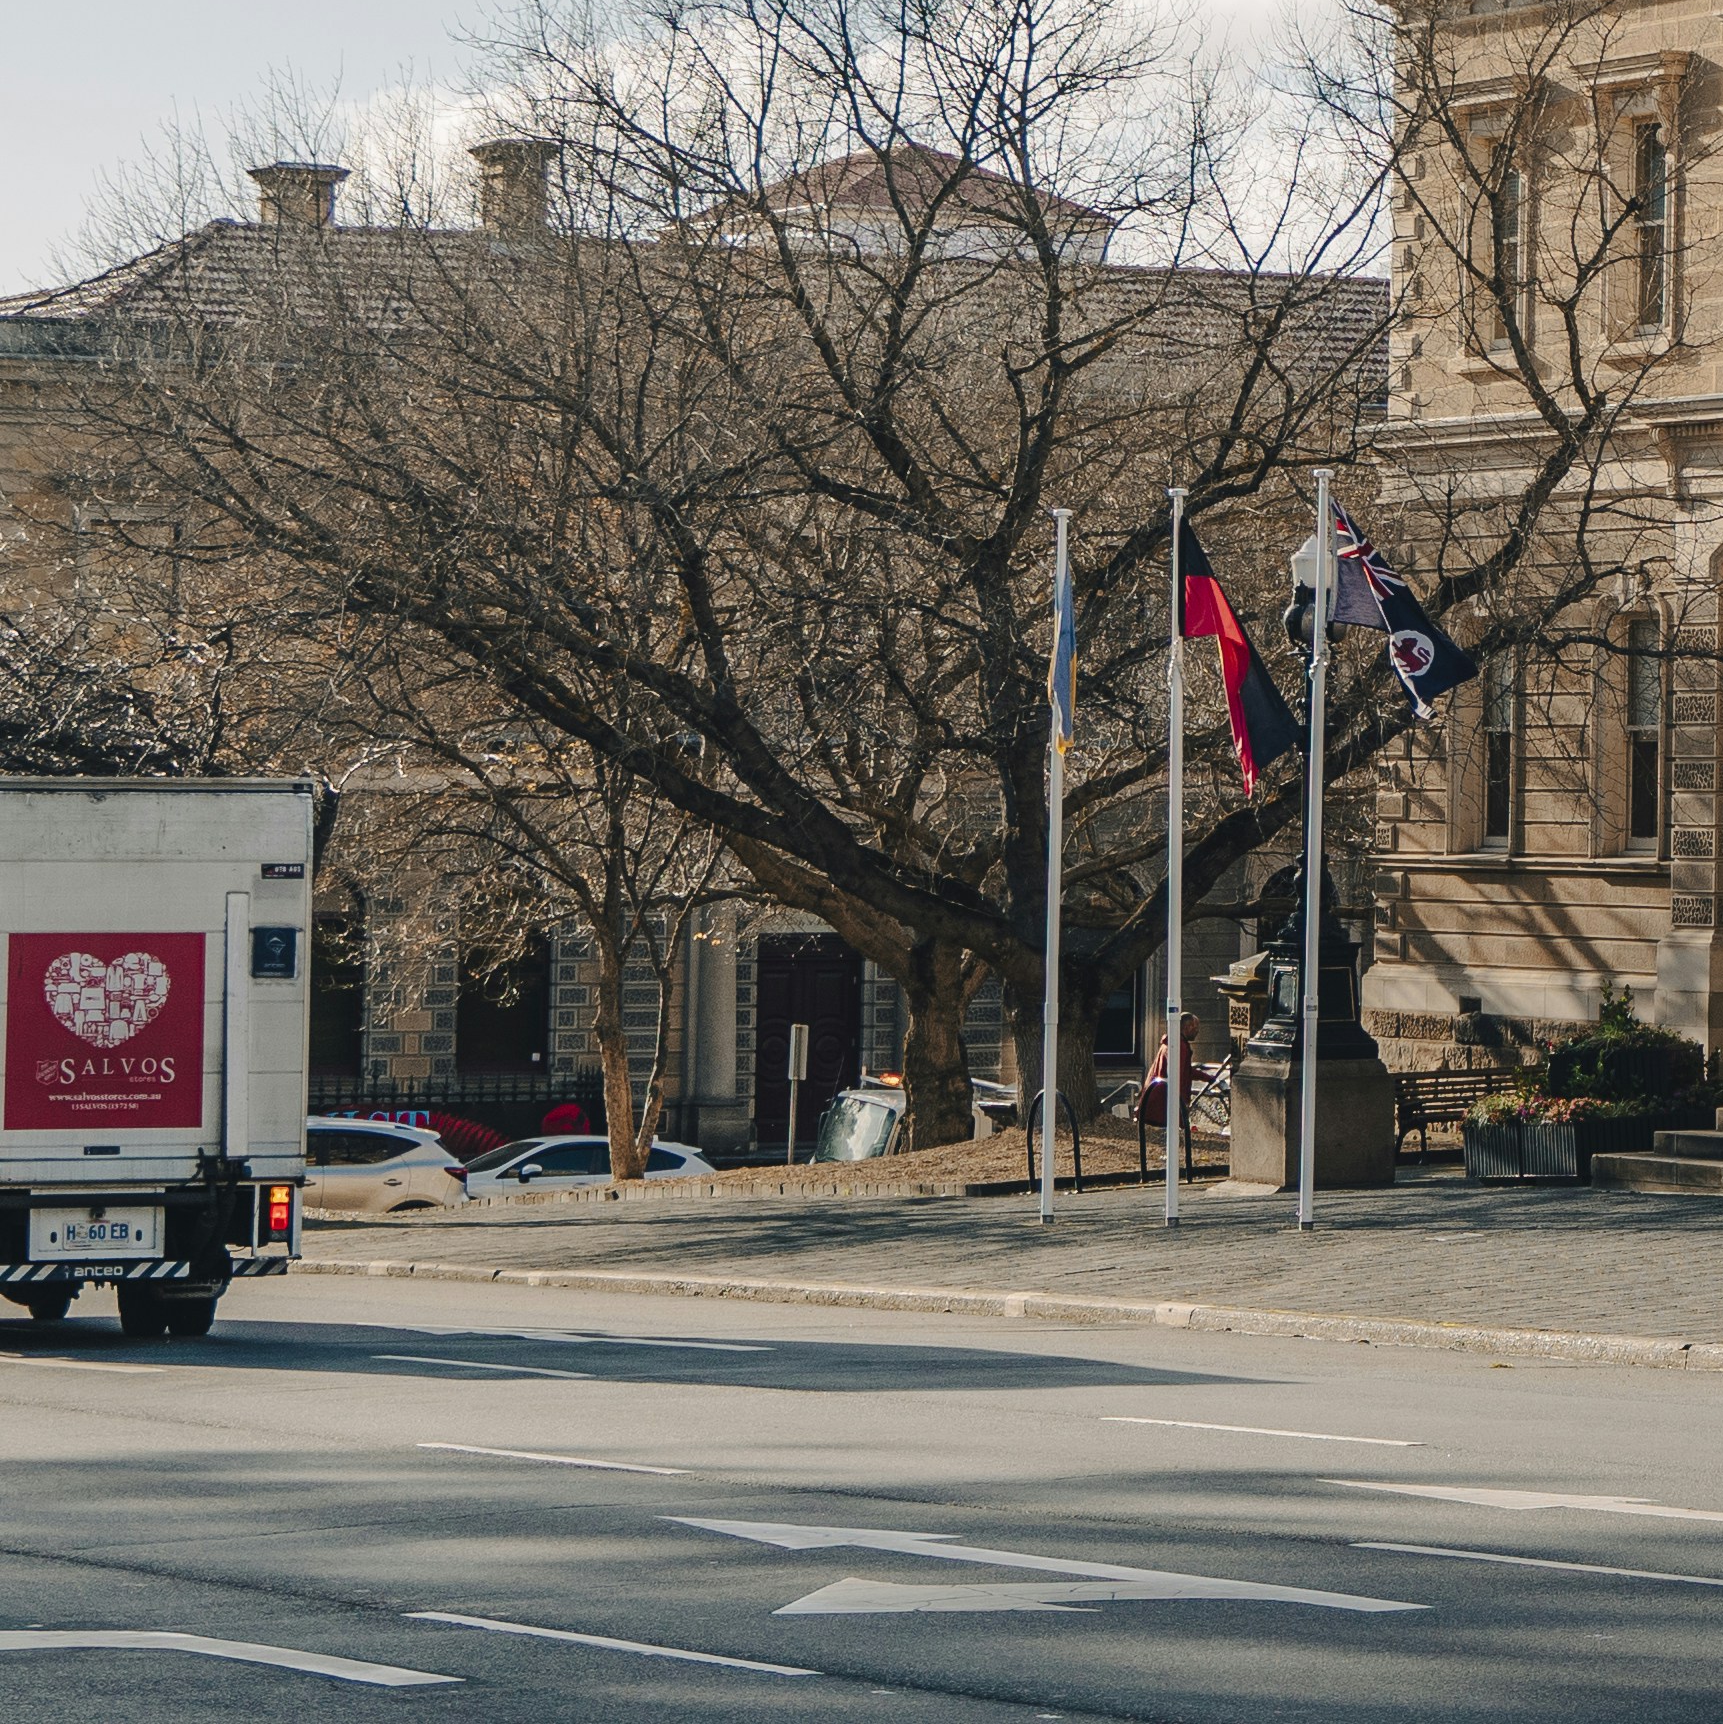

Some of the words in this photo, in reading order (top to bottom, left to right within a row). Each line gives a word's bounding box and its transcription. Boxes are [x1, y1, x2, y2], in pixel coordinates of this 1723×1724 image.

[60, 1057, 176, 1084] SALVOS
[48, 1092, 161, 1101] www.salvosstores.com.au
[67, 1225, 76, 1240] H
[89, 1225, 106, 1239] 60
[111, 1223, 128, 1239] EB
[74, 1266, 123, 1276] anteo
